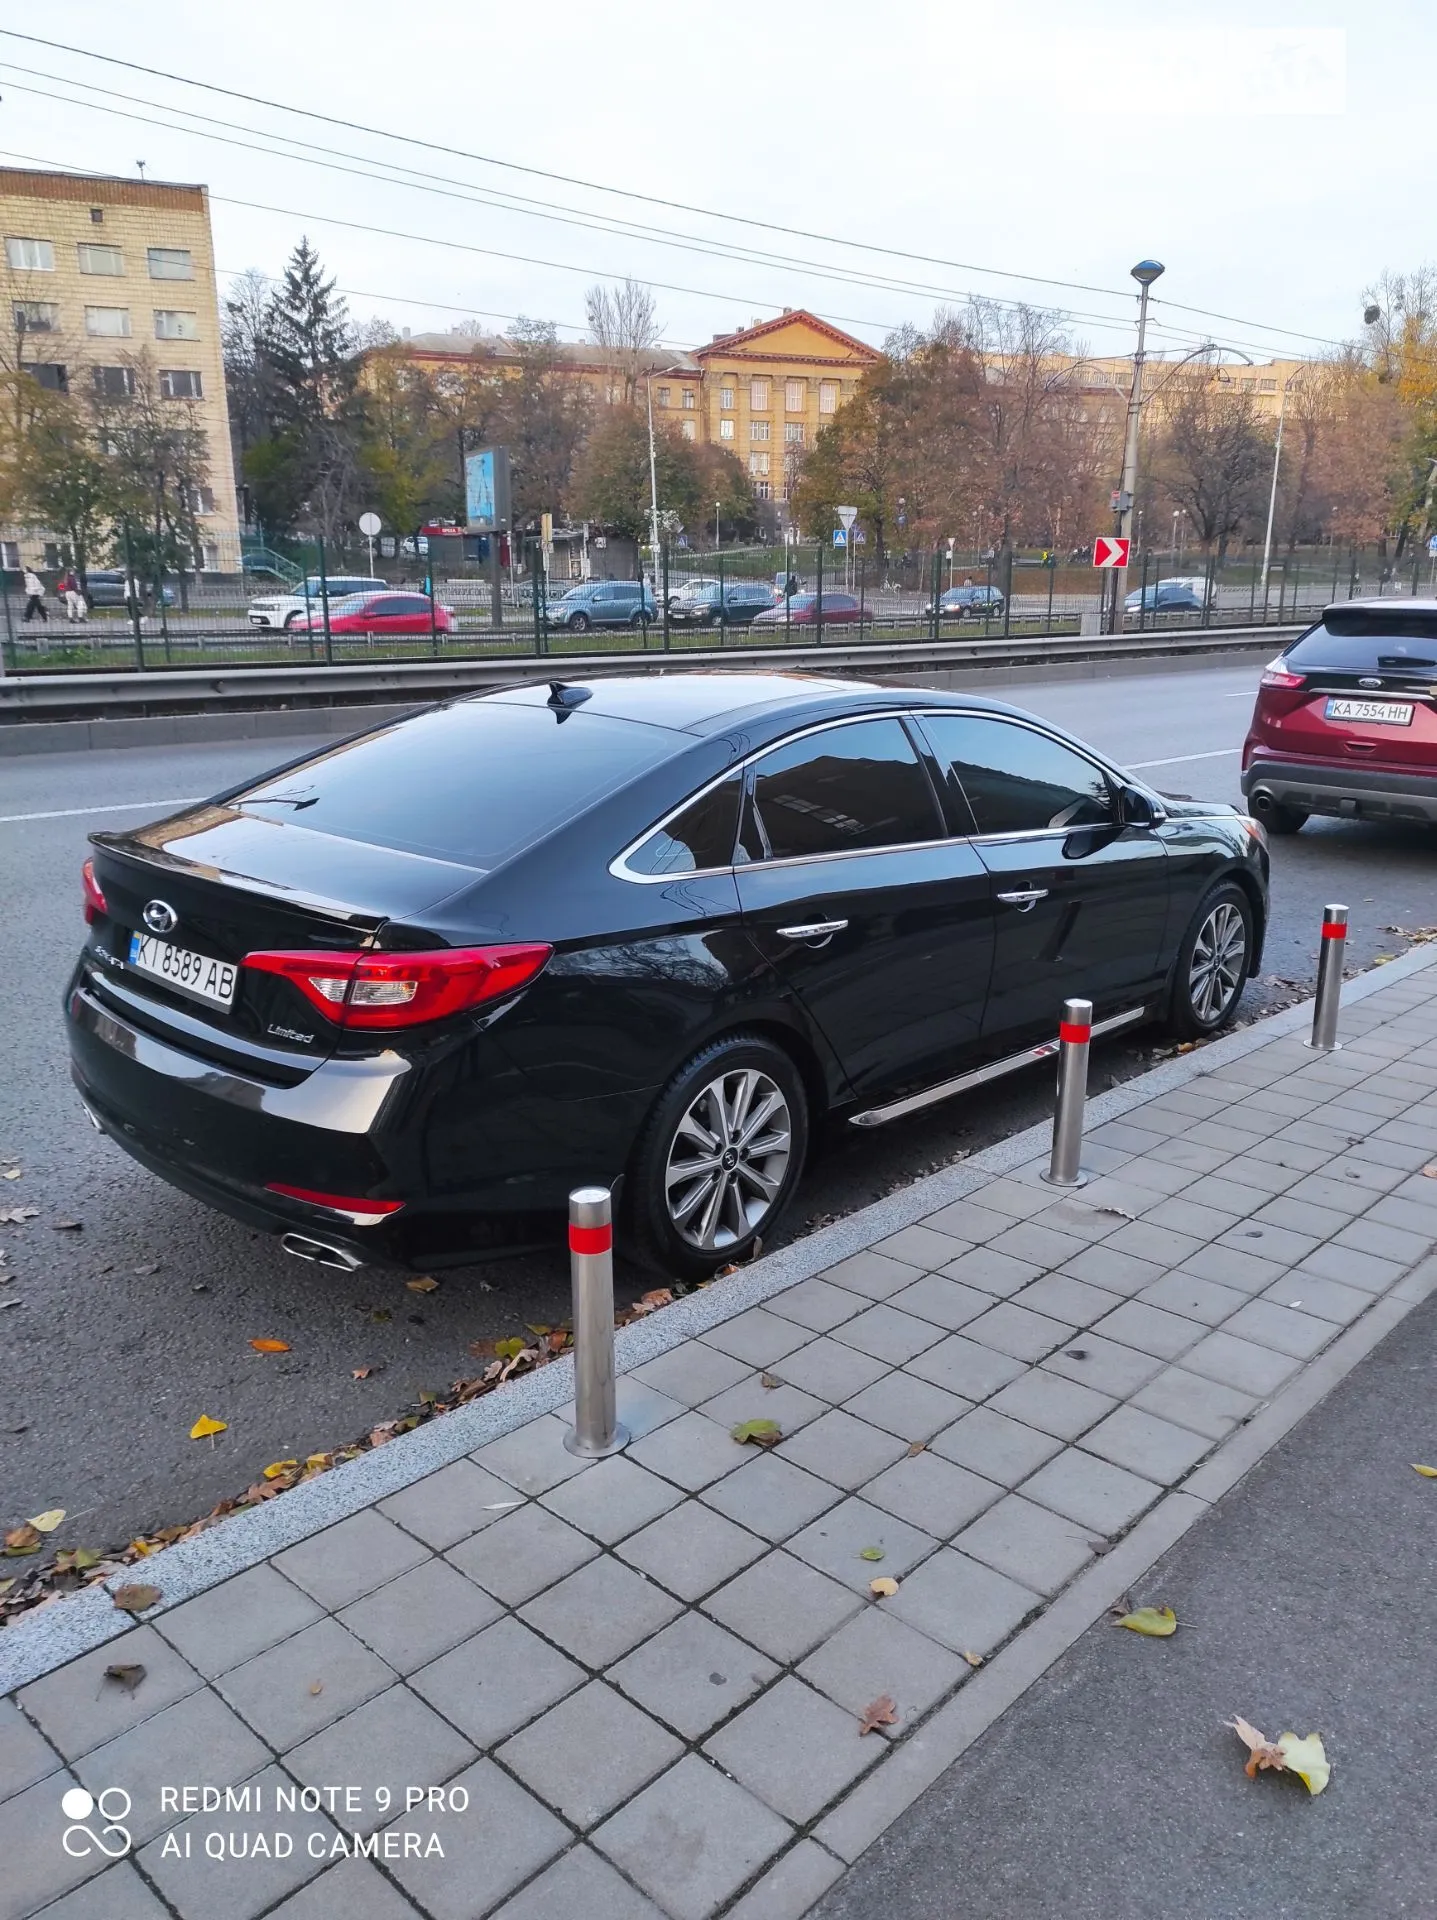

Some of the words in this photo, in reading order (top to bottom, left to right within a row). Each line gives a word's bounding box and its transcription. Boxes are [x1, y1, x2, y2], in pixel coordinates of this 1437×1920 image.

[1333, 702, 1351, 716] KA
[1355, 704, 1385, 718] 7554
[1388, 706, 1408, 720] HH
[138, 934, 158, 968] KI
[162, 944, 202, 986] 8589
[204, 962, 234, 999] AB
